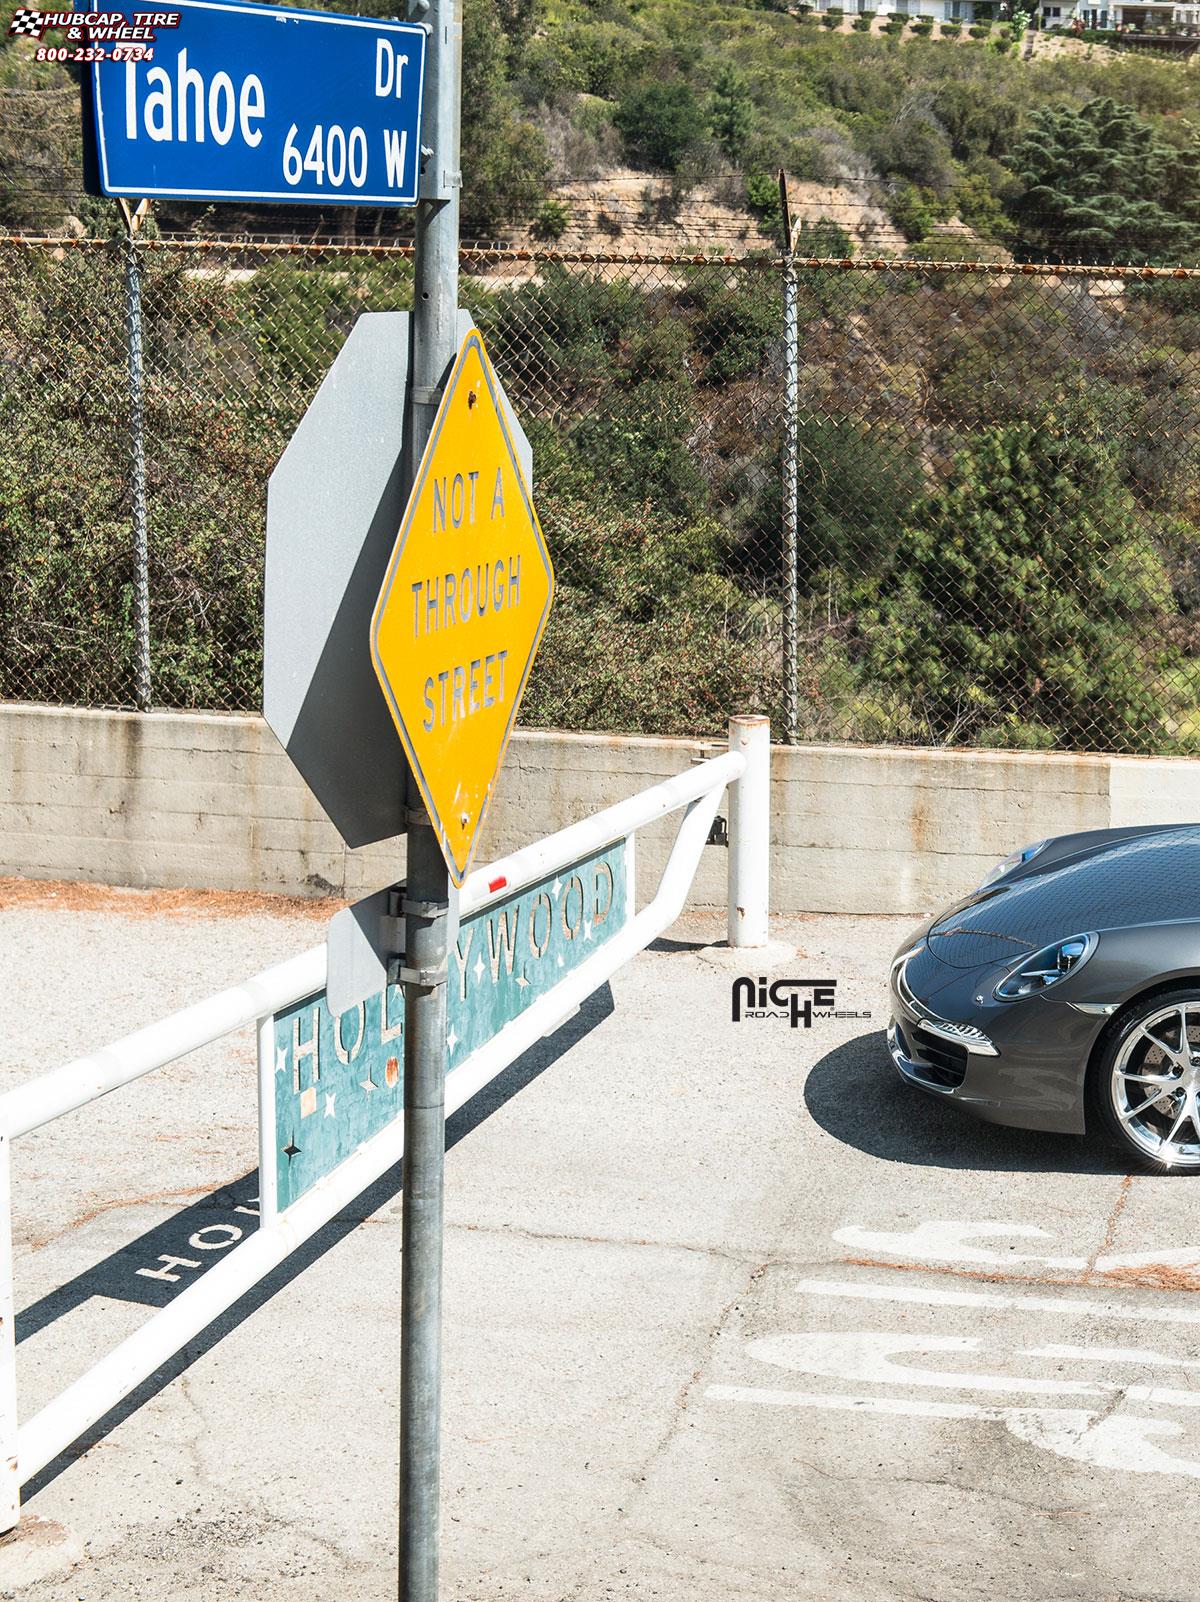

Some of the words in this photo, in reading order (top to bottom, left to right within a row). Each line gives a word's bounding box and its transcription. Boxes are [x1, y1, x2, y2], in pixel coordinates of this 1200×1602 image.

[115, 42, 266, 148] Tahoe
[374, 37, 409, 99] Dr
[282, 122, 369, 189] 6400
[383, 128, 408, 189] W
[432, 471, 480, 534] NOT
[489, 466, 506, 519] A
[411, 554, 522, 638] THROUGH
[422, 650, 509, 733] STREET
[292, 861, 615, 1094] HOLYWOOD
